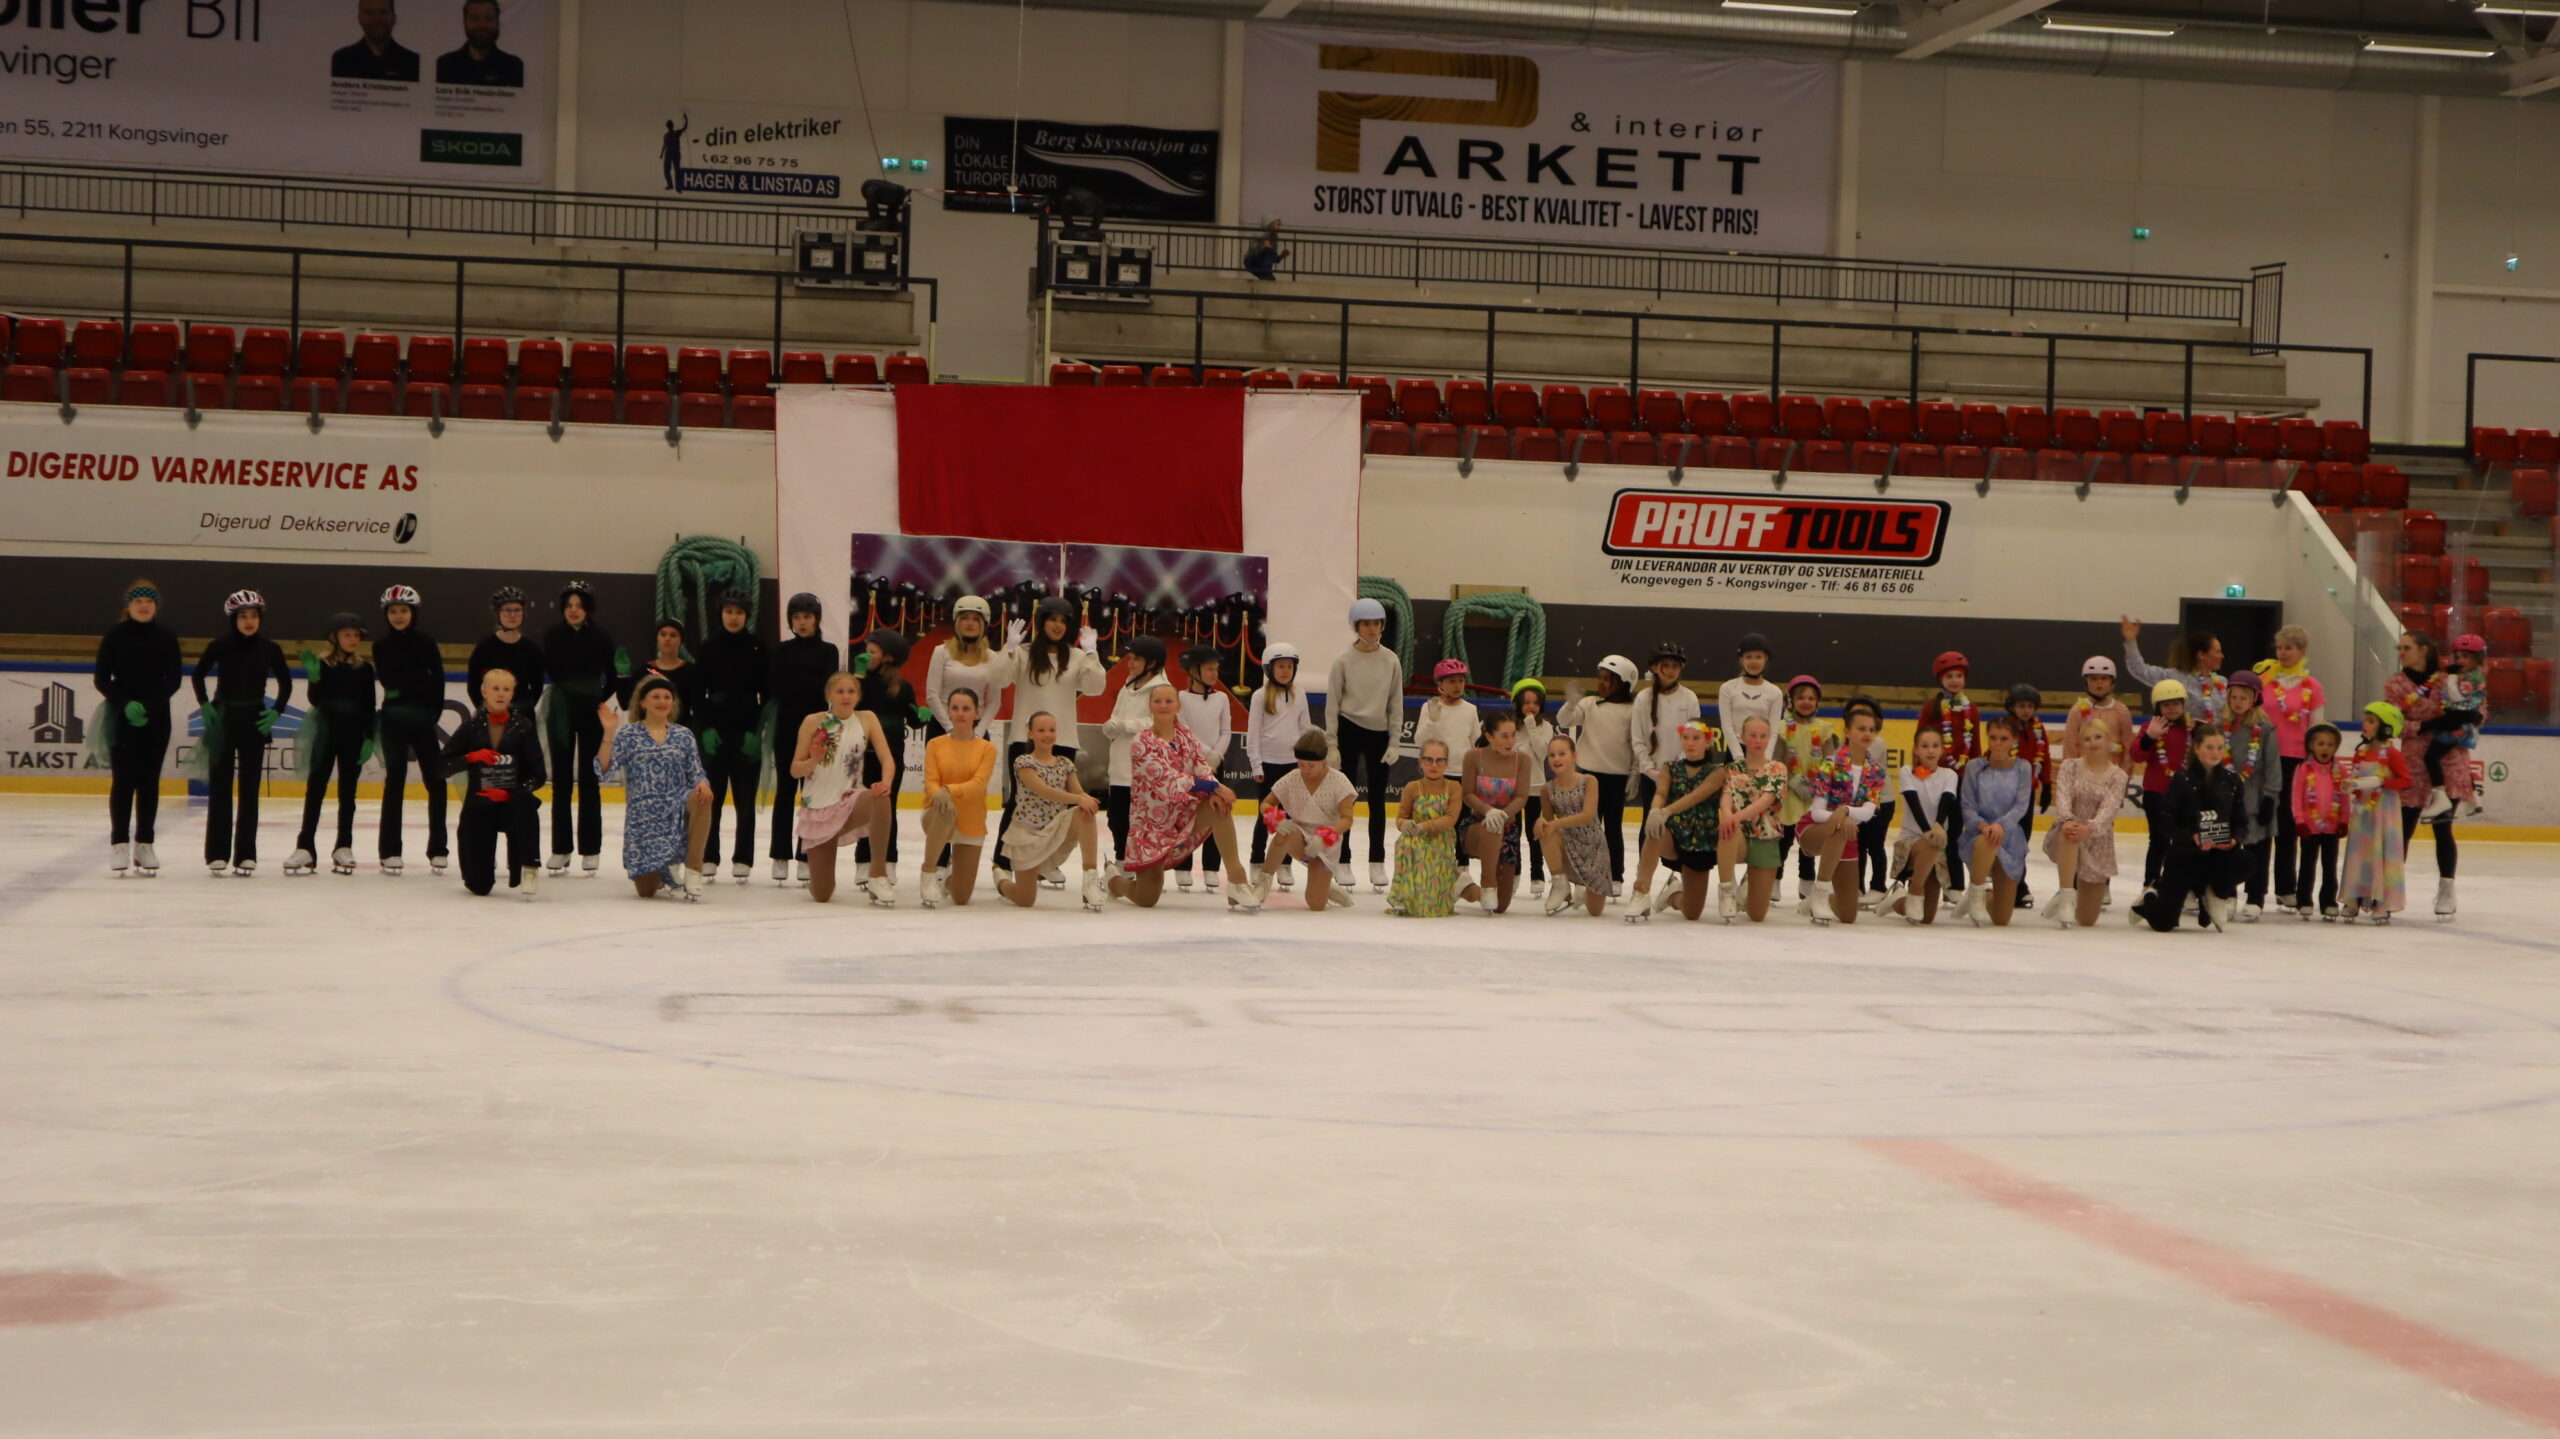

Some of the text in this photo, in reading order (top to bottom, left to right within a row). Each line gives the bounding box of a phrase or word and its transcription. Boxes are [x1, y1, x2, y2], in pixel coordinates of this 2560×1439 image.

[24, 119, 55, 138] 55,
[62, 121, 103, 138] 2211
[108, 124, 229, 148] Kongsvinger
[705, 124, 738, 148] din
[744, 117, 842, 143] elektriker
[1615, 115, 1764, 143] interiør
[954, 135, 980, 150] DIN
[1034, 130, 1210, 156] Berg Skysstasjon as
[710, 153, 729, 165] 62
[733, 154, 752, 166] 96
[954, 152, 1009, 169] LOKALE
[683, 172, 836, 196] HAGEN & LINSTAD AS
[954, 171, 1058, 189] TUROPERATØR
[1314, 185, 1387, 215] STØRST
[1391, 189, 1463, 219] UTVALG
[1481, 195, 1529, 222] BEST
[1533, 196, 1621, 228] KVALITET
[1639, 202, 1708, 233] LAVEST
[1712, 207, 1759, 236] PRIS!
[7, 451, 419, 491] DIGERUD VARMESERVICE AS
[200, 513, 391, 534] Digerud Dekkservice
[1611, 558, 1925, 581] DIN LEVERANDØR AV VERKTØY OG SVEISEMATERIELL
[1621, 573, 1702, 589] Kongevegen
[1706, 576, 1714, 587] 5
[1725, 576, 1808, 592] Kongsvinger
[1820, 580, 1840, 592] Tlf:
[1844, 581, 1859, 592] 46
[1863, 581, 1877, 592] 81
[1881, 582, 1896, 593] 65
[1899, 583, 1914, 594] 06
[7, 751, 78, 769] TAKST
